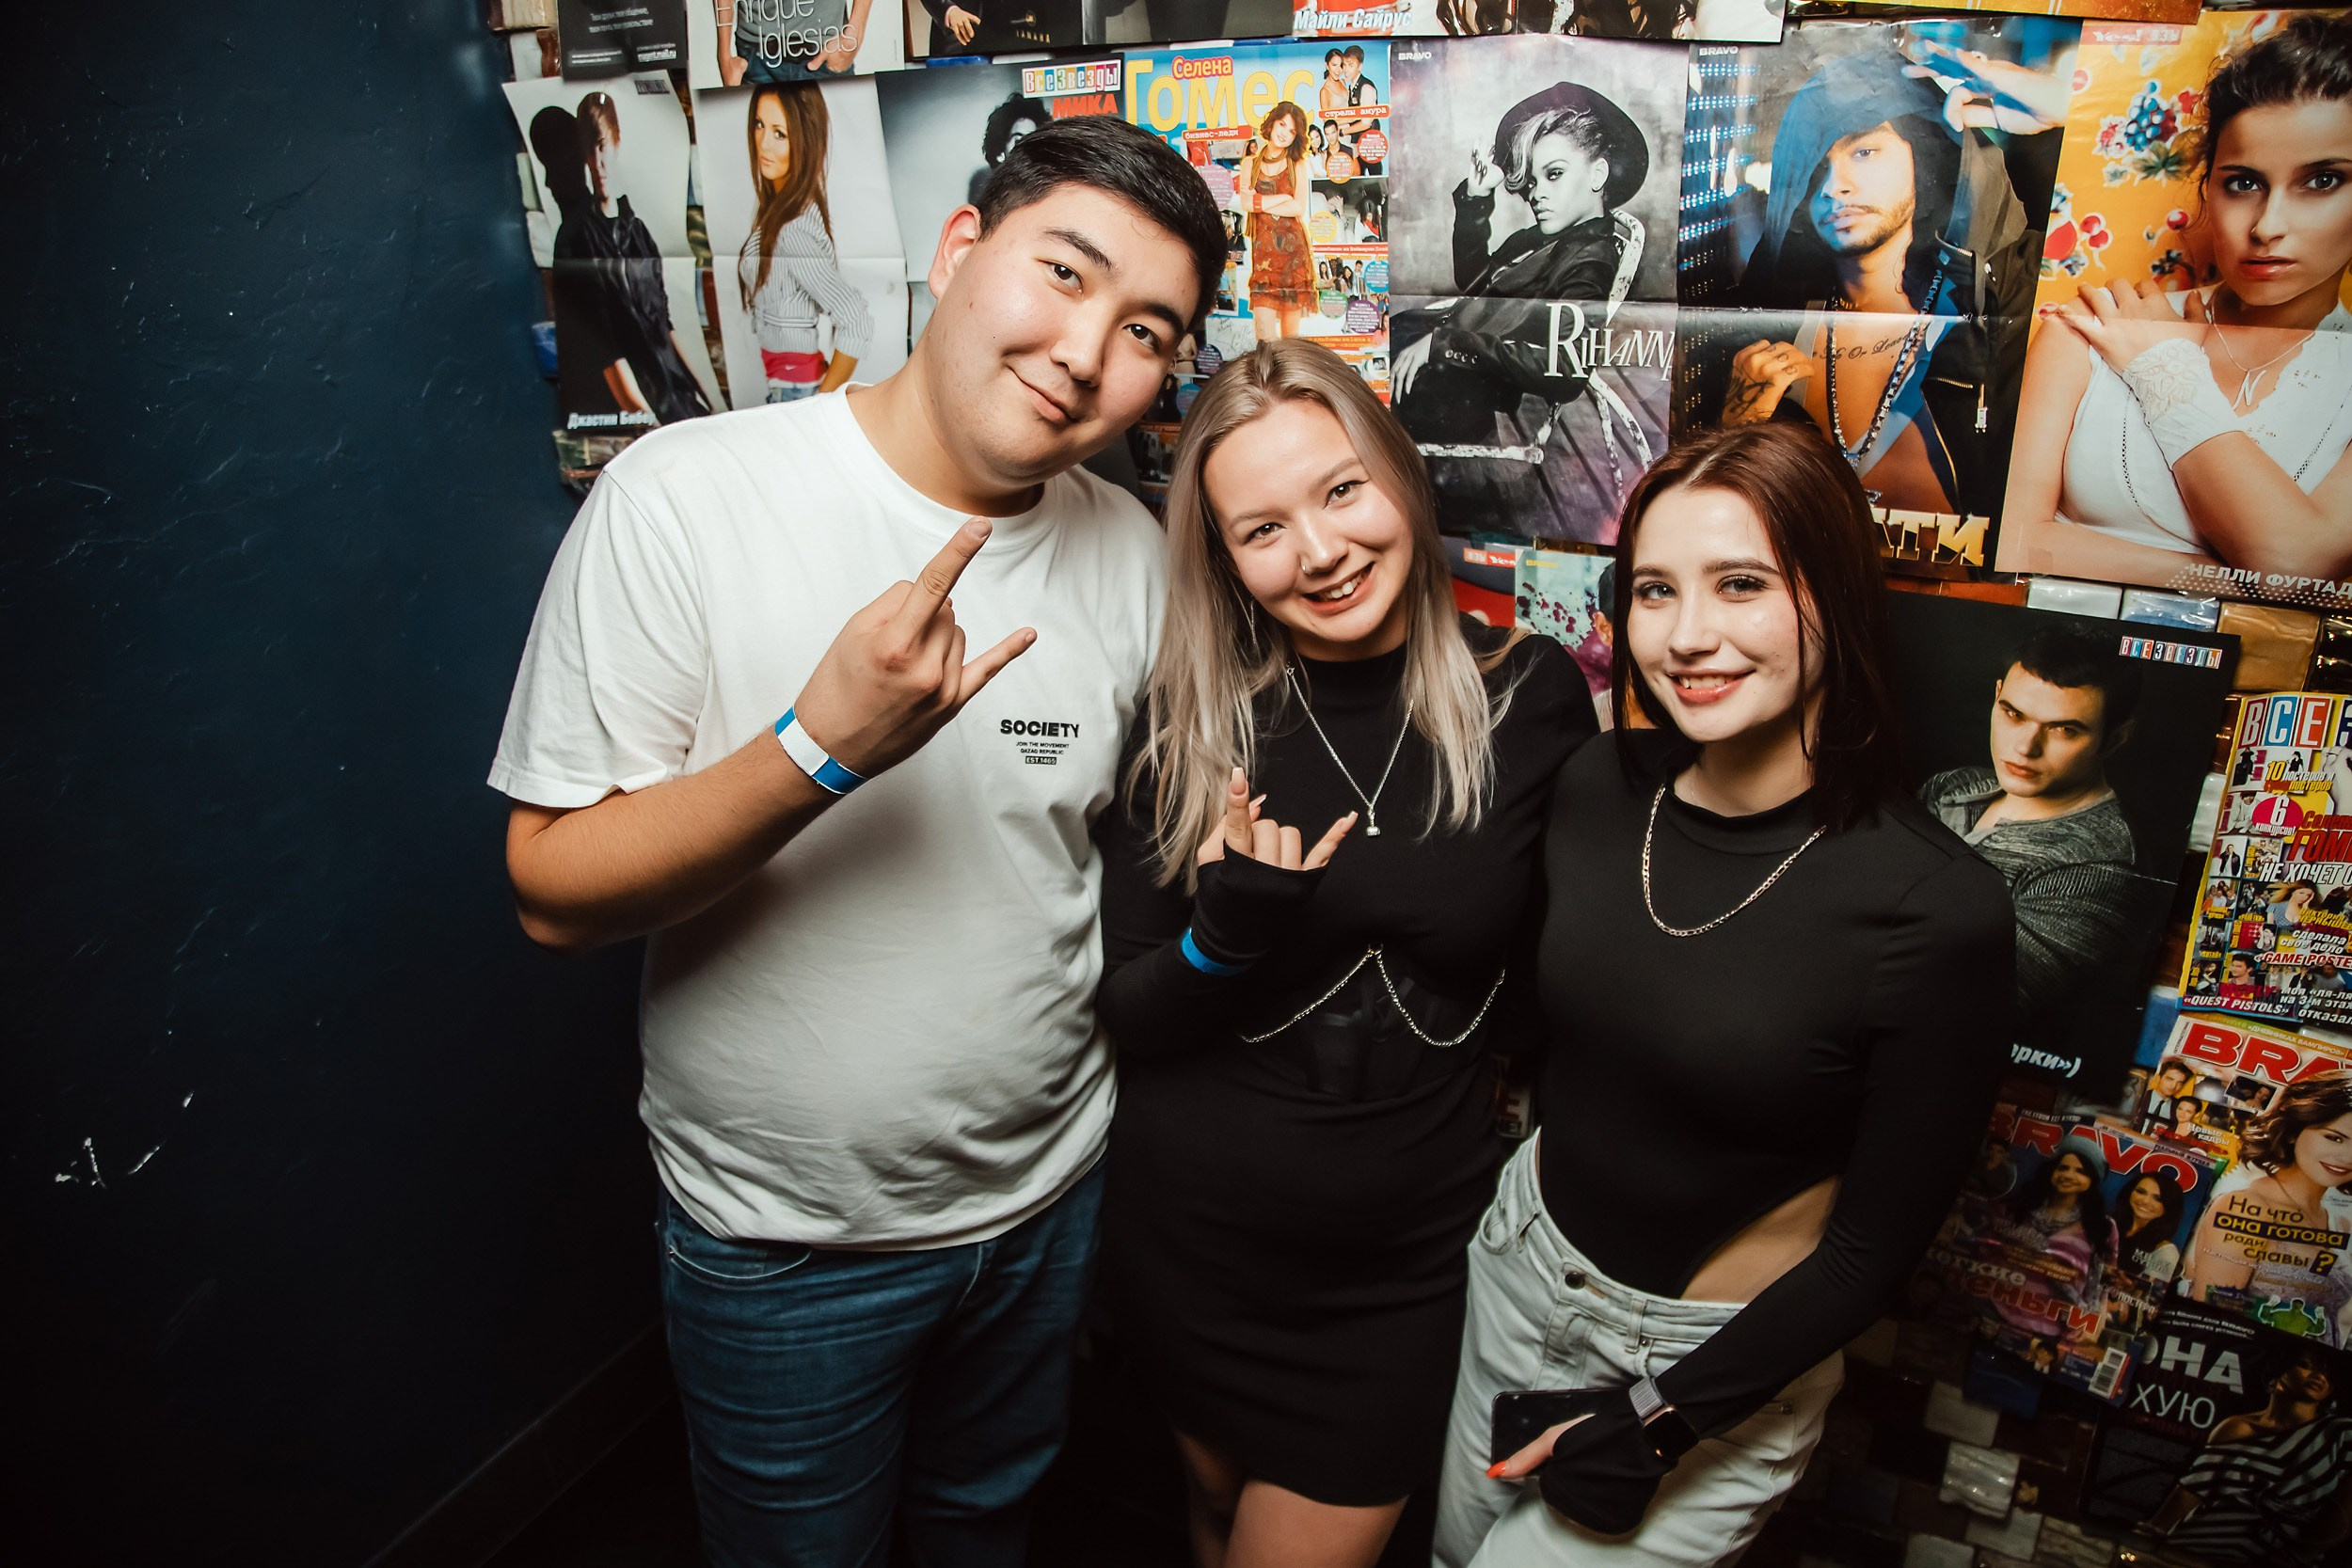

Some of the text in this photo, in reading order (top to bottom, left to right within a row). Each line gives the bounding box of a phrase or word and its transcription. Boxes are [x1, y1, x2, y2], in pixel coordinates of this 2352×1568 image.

[1294, 8, 1412, 32] Майли Сайрус
[757, 19, 858, 69] Iglesias
[1699, 46, 1739, 56] BRAVO
[1398, 51, 1432, 60] BRAVO
[1173, 57, 1233, 78] Селена
[1052, 94, 1118, 119] МИКА
[1125, 59, 1314, 134] Гомес
[567, 412, 618, 430] Джастин
[2189, 563, 2261, 585] НЕЛЛИ
[1000, 719, 1080, 738] SOCIETY
[2241, 700, 2328, 747] ВСЕ
[2265, 760, 2287, 782] 10
[2282, 770, 2327, 783] постеров
[2289, 781, 2332, 792] постеров
[2269, 796, 2290, 826] 6
[2255, 822, 2296, 836] конкурсов!
[2259, 862, 2284, 882] НЕ
[2292, 929, 2347, 945] сделала
[2255, 952, 2304, 965] «GAME
[2311, 941, 2344, 955] дело
[2184, 995, 2290, 1016] «QUEST PISTOLS»
[2280, 995, 2296, 1004] на
[2248, 1024, 2296, 1043] «ДНЕВНИКАХ
[2297, 1037, 2345, 1055] ВАМПИРОВ»
[2228, 1195, 2305, 1224] На что
[2217, 1215, 2344, 1248] она готова
[2223, 1232, 2265, 1249] ради
[2243, 1246, 2310, 1268] славы
